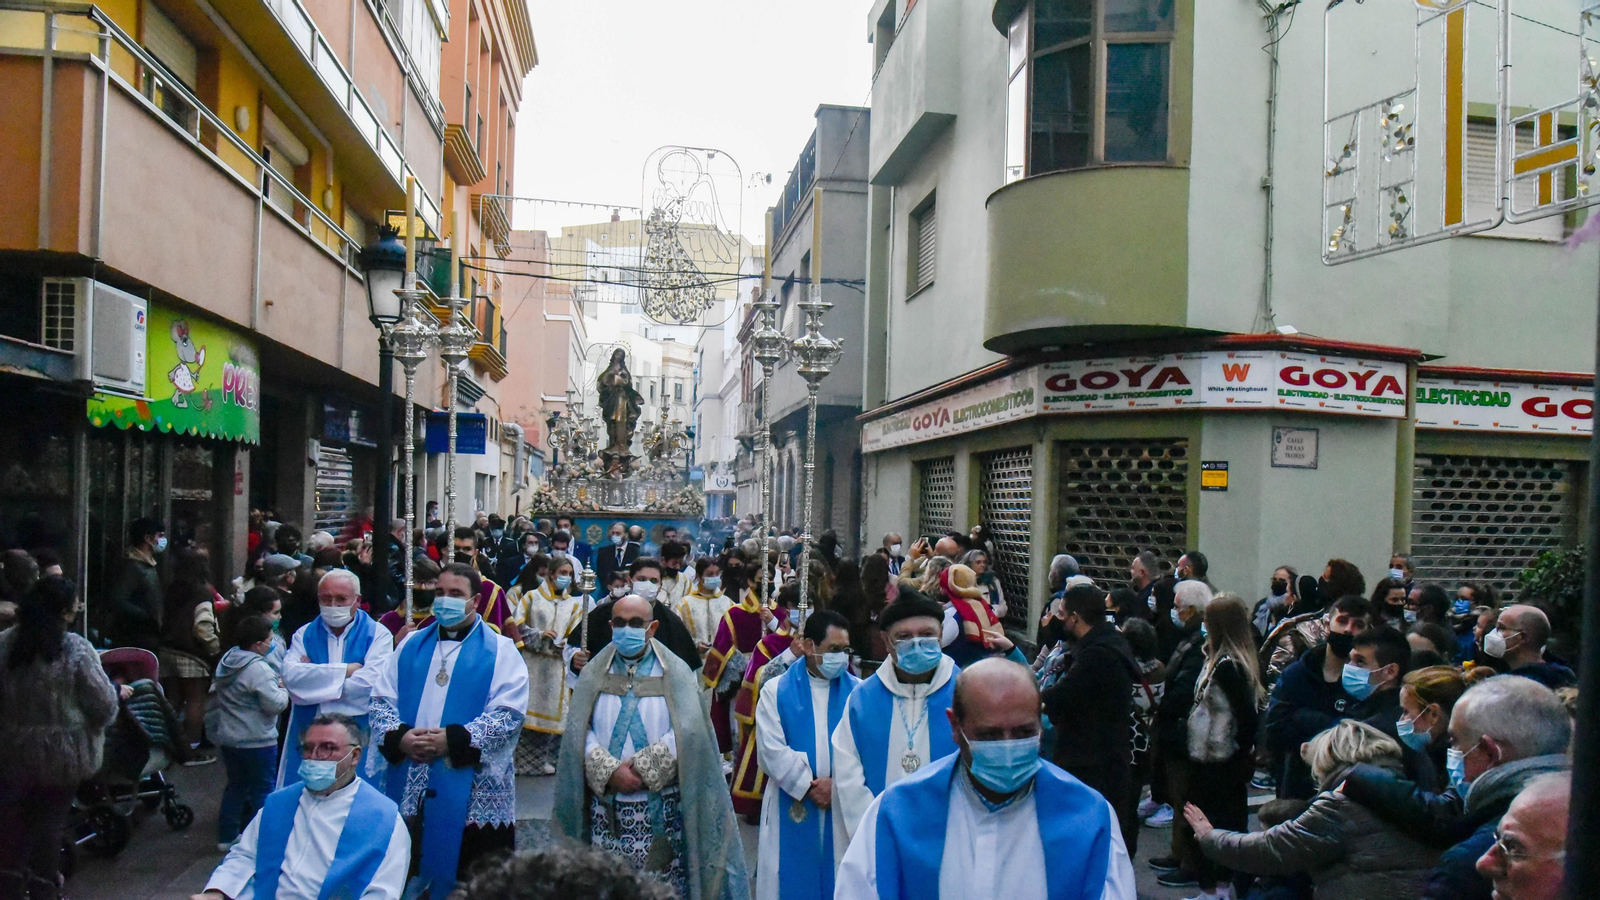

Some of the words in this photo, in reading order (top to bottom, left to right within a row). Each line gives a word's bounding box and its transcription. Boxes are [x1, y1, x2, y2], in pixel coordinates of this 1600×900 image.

[1045, 364, 1190, 392] GOYA
[1222, 363, 1250, 382] W
[1279, 366, 1404, 396] GOYA
[1044, 393, 1098, 403] ELECTRICIDAD
[1277, 388, 1329, 399] ELECTRICIDAD
[1416, 387, 1511, 407] ELECTRICIDAD
[913, 407, 950, 432] GOYA
